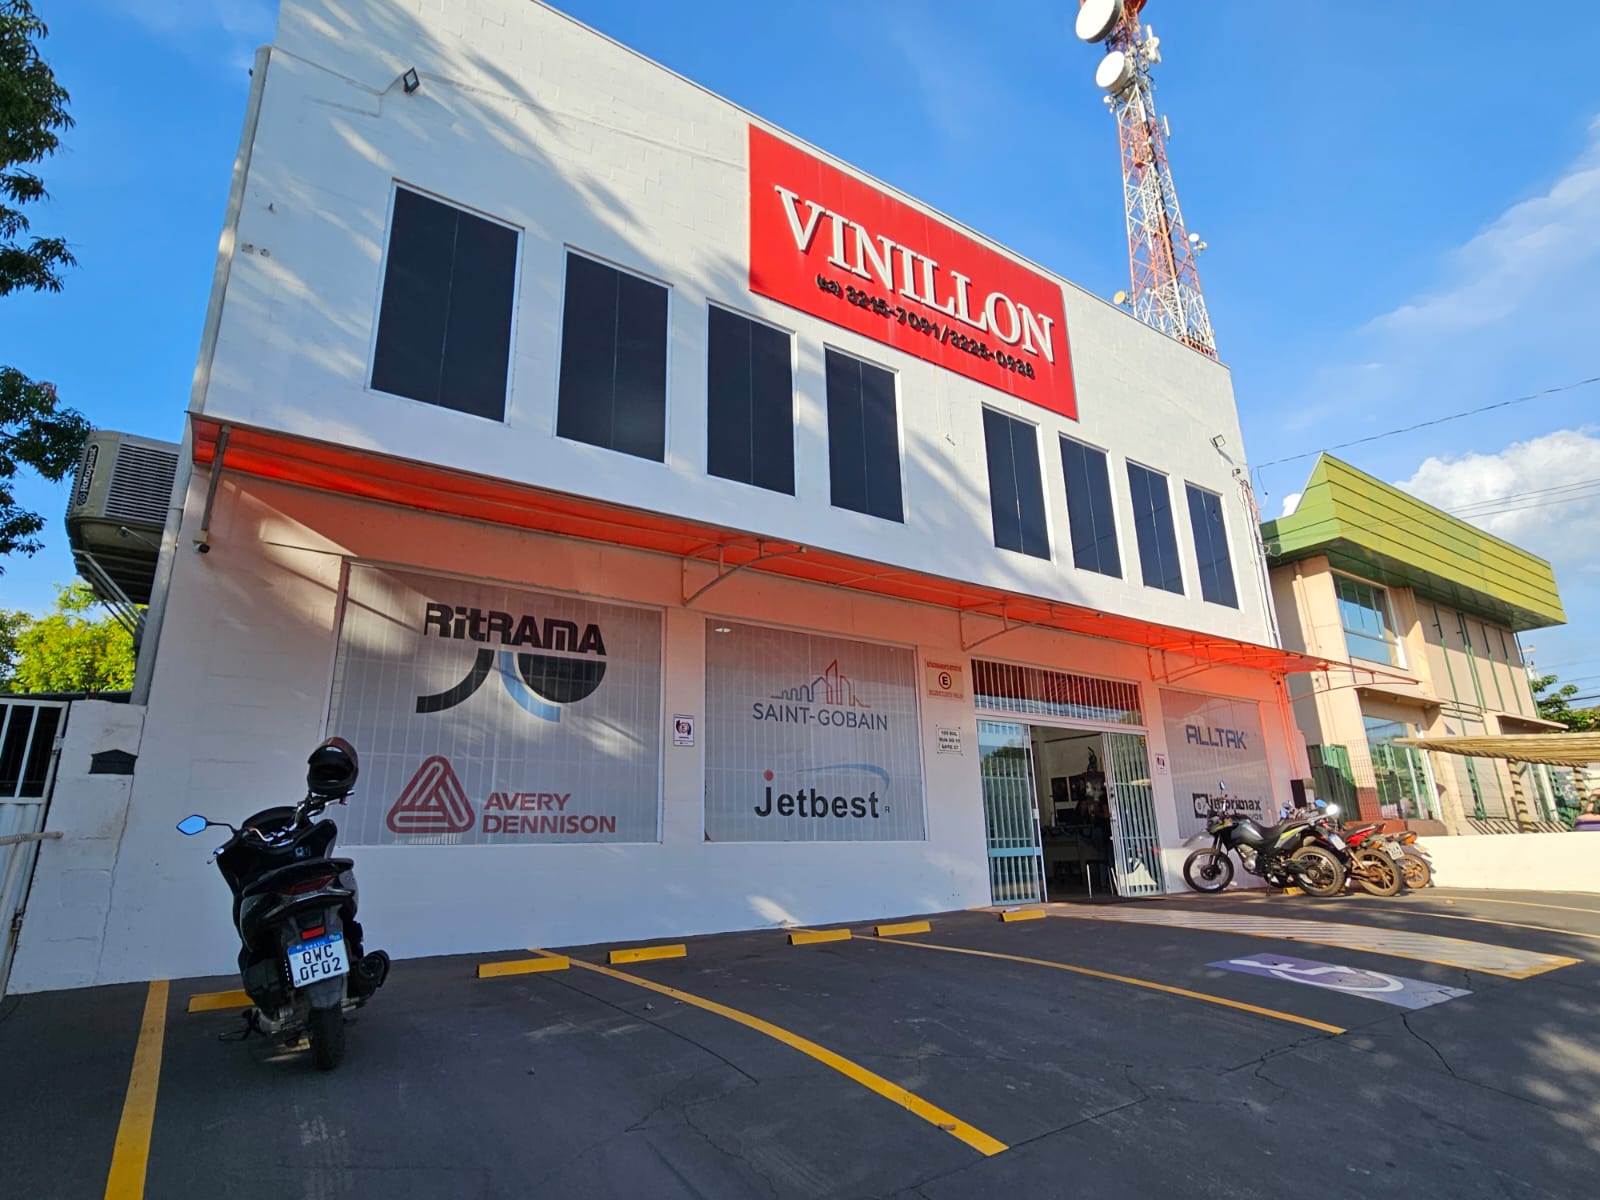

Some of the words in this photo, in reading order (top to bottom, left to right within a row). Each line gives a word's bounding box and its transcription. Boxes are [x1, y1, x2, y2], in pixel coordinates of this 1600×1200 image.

[774, 185, 1055, 364] VINILLON
[80, 447, 97, 492] Rotoplast
[752, 702, 888, 731] SAINT-GOBAIN
[1185, 724, 1247, 750] ALLTAK
[484, 792, 571, 811] AVERY
[482, 815, 616, 834] DENNISON
[302, 944, 334, 965] QWC
[299, 957, 342, 981] 0F02
